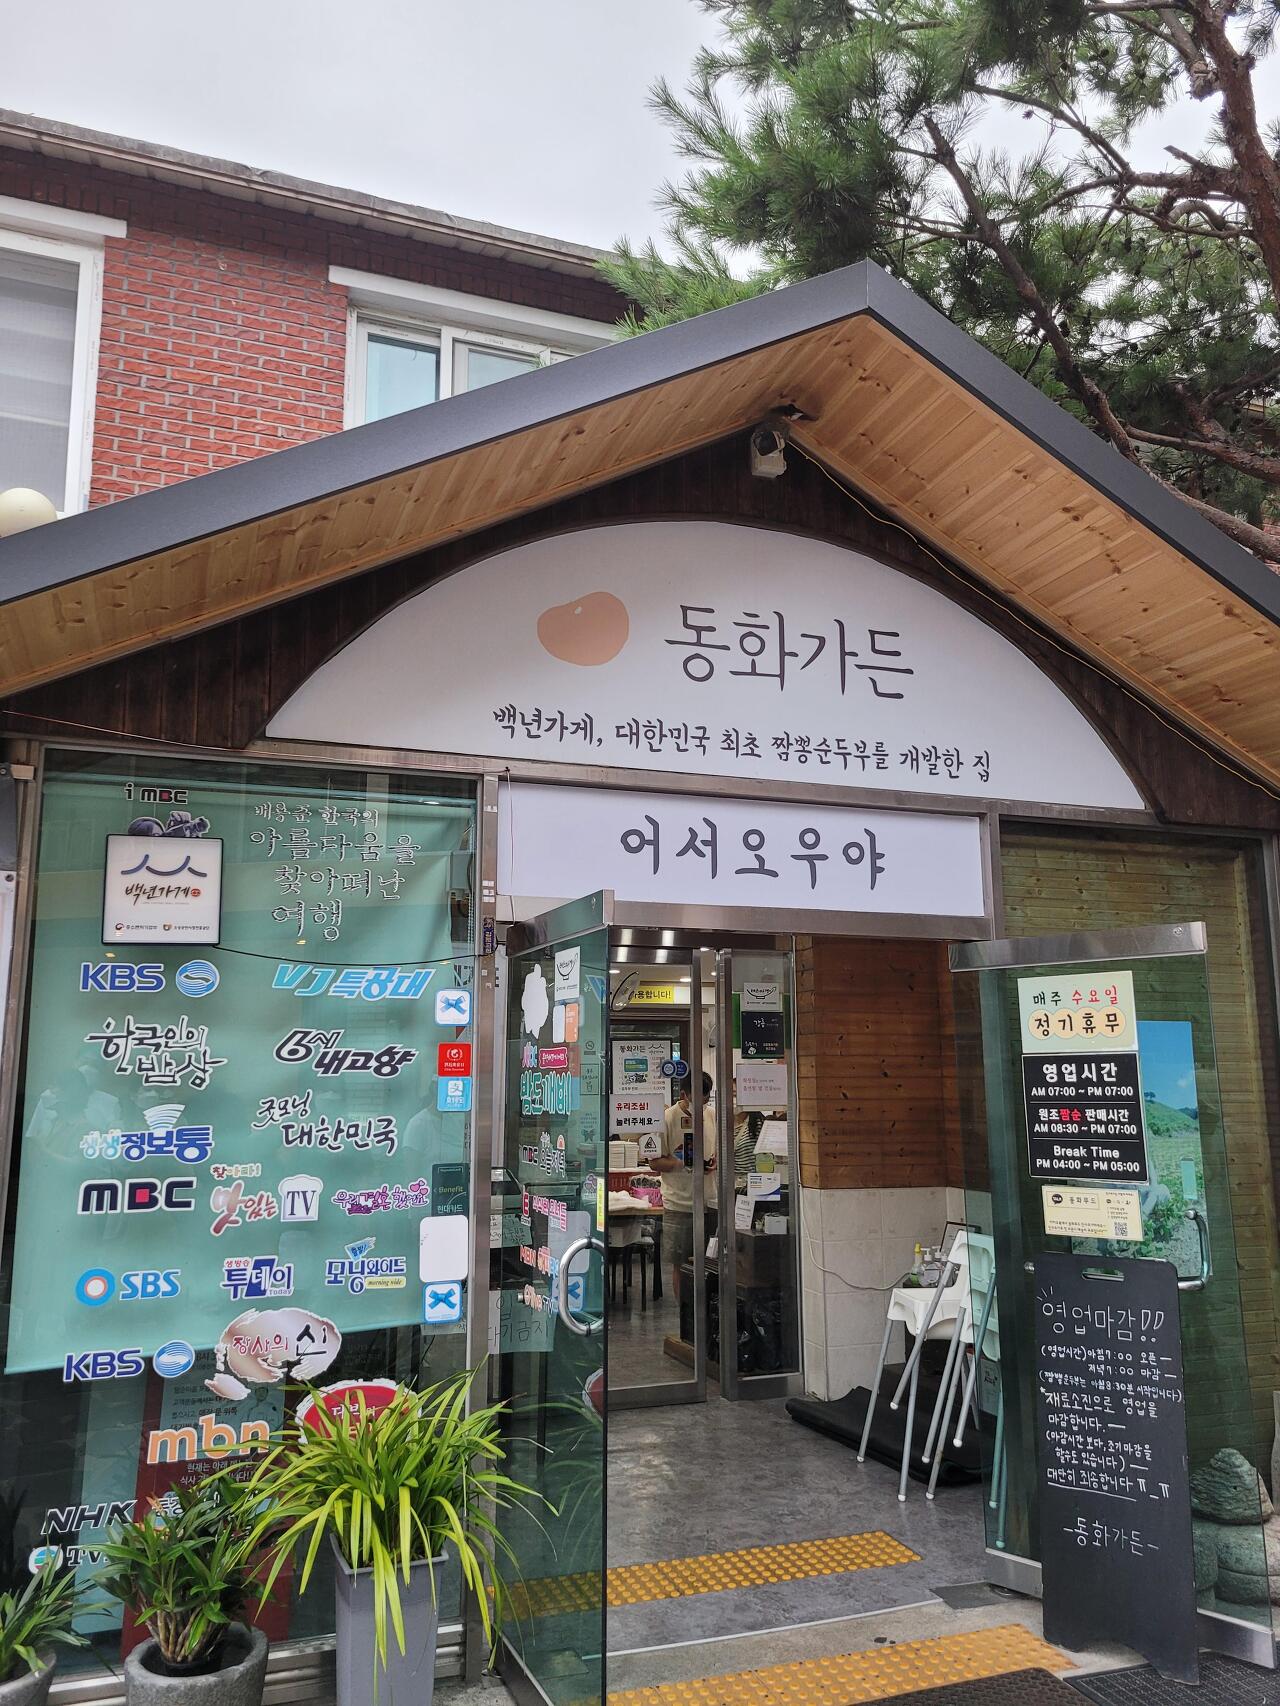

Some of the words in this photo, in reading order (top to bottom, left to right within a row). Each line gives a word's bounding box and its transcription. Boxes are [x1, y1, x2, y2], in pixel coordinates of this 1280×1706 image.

[664, 604, 914, 700] 동화가든
[493, 703, 603, 748] 백년가게,
[615, 718, 710, 756] 대한민국
[720, 728, 762, 759] 최초
[771, 734, 890, 770] 짬뽕순두부를
[900, 746, 963, 779] 개발한
[973, 754, 991, 783] 집
[319, 805, 378, 828] 한국의
[250, 827, 421, 866] 아름다움을
[620, 814, 886, 891] 어서오우야
[125, 883, 190, 906] 백년가게
[272, 899, 342, 941] 여행
[80, 962, 165, 993] KBS
[273, 964, 336, 996] VJ
[328, 966, 435, 1001] 특공대
[1033, 991, 1061, 1006] 매주
[1072, 985, 1118, 1005] 수요일
[1035, 1013, 1119, 1036] 정기휴무
[85, 1015, 209, 1073] 한국인의
[273, 1029, 343, 1064] 6시
[137, 1048, 228, 1090] 밥상
[312, 1044, 419, 1078] 내고향
[1043, 1063, 1117, 1082] 영업시간
[1031, 1087, 1045, 1096] AM
[1048, 1087, 1075, 1096] 07:00
[1088, 1087, 1101, 1096] PM
[1105, 1086, 1133, 1096] 07:00
[252, 1089, 313, 1129] 굿모닝
[616, 1102, 649, 1111] 유리조심!
[1039, 1108, 1081, 1121] 원조짬순
[1085, 1109, 1129, 1122] 판매시간
[281, 1117, 398, 1156] 대한민국
[1034, 1124, 1048, 1133] AM
[1051, 1124, 1078, 1133] 08:30
[1091, 1124, 1105, 1134] PM
[1108, 1124, 1137, 1134] 07:00
[1036, 1159, 1050, 1168] PM
[1053, 1160, 1081, 1169] 04:00
[1093, 1161, 1107, 1170] PM
[1111, 1161, 1139, 1171] 05:00
[1053, 1146, 1087, 1157] Break
[1091, 1147, 1119, 1158] Time
[77, 1177, 197, 1215] MBC
[286, 1190, 317, 1216] TV
[438, 1186, 463, 1194] Benefit
[437, 1204, 463, 1213] 현대카드
[120, 1270, 181, 1299] SBS
[221, 1265, 293, 1299] 투데이
[326, 1258, 406, 1294] 모닝와이드
[1042, 1301, 1164, 1342] 영업마감!!
[232, 1334, 288, 1356] 장사의
[295, 1323, 328, 1356] 신
[63, 1348, 144, 1382] KBS
[1140, 1368, 1161, 1381] 마감
[1045, 1392, 1115, 1414] 재료소진으로
[1122, 1397, 1158, 1418] 영업을
[1137, 1385, 1182, 1403] 시작입니다)
[1048, 1414, 1106, 1432] 마감합니다.
[147, 1413, 270, 1464] mbn
[1046, 1431, 1084, 1445] (마감시간
[1123, 1442, 1152, 1461] 마감을
[1081, 1452, 1125, 1472] 있습니다)
[1047, 1468, 1075, 1485] 대단히
[1079, 1470, 1134, 1492] 죄송합니다
[41, 1500, 137, 1535] NHK
